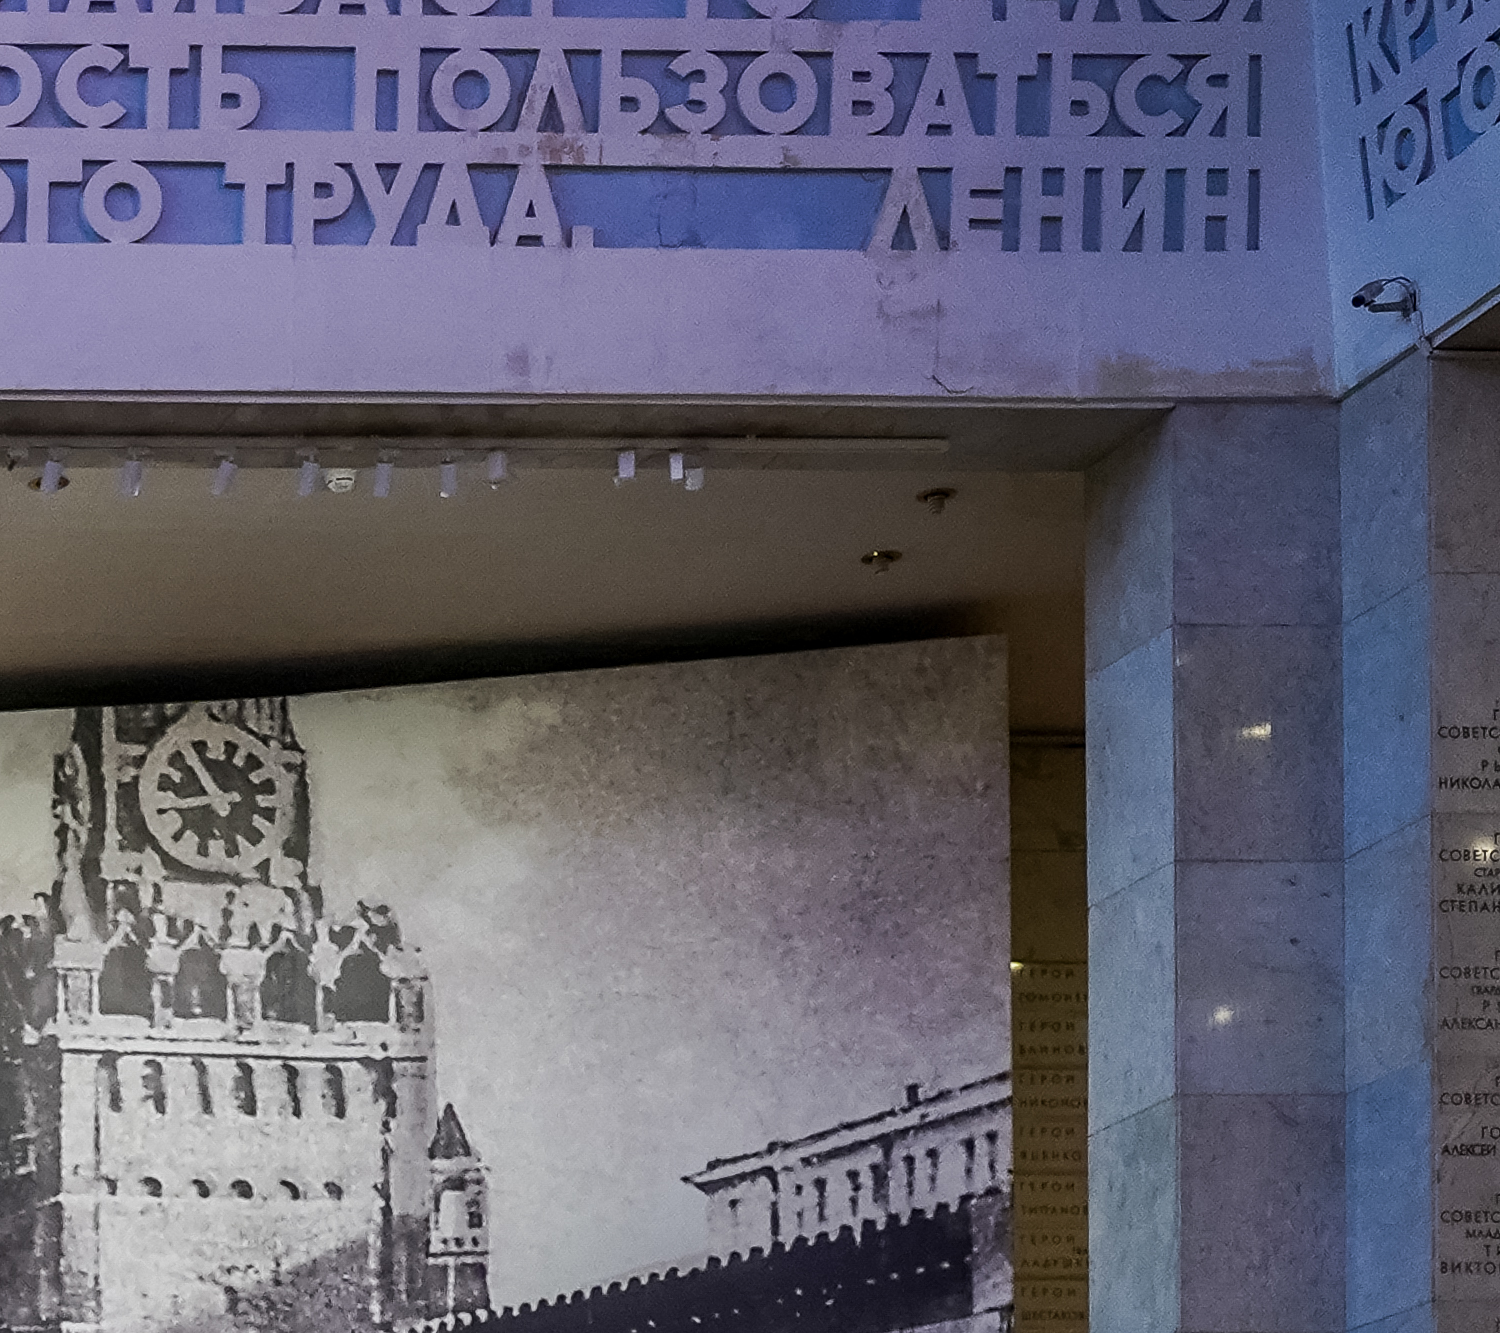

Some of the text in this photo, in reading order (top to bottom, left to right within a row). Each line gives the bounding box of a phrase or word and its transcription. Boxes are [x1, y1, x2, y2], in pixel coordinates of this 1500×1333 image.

[355, 45, 1246, 137] ПОЛЬЗОВАТЬСЯ
[223, 160, 594, 249] ТРУДА.
[868, 166, 1247, 252] ЛЕНИН
[1440, 1260, 1497, 1275] ВИКТО
